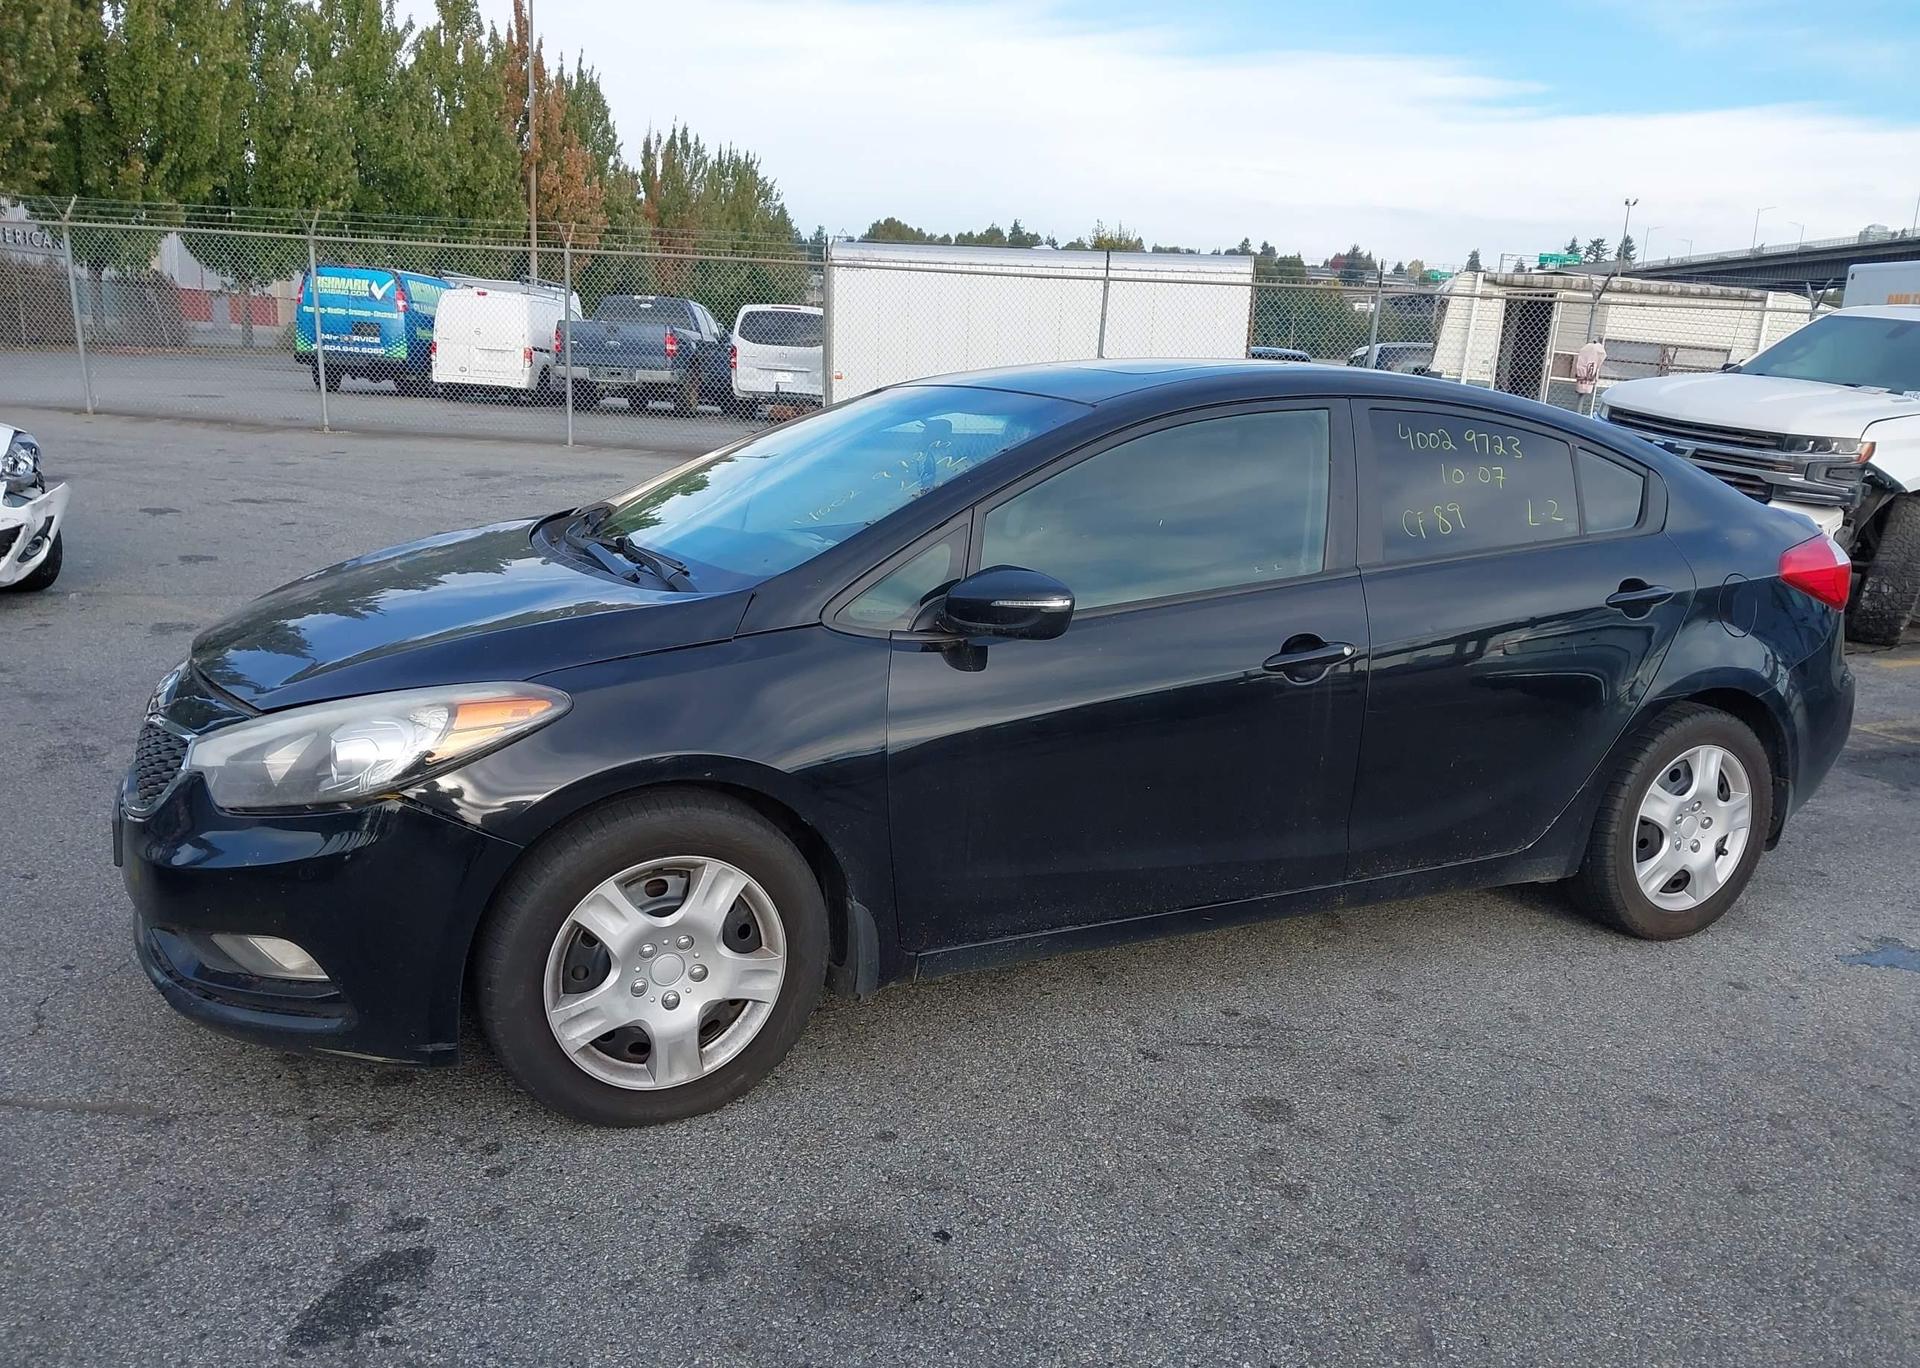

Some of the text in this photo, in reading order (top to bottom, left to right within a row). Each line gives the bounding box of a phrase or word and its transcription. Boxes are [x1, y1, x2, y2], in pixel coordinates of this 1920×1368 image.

[0, 226, 65, 250] ERICAN
[1398, 423, 1523, 459] 4002 9723
